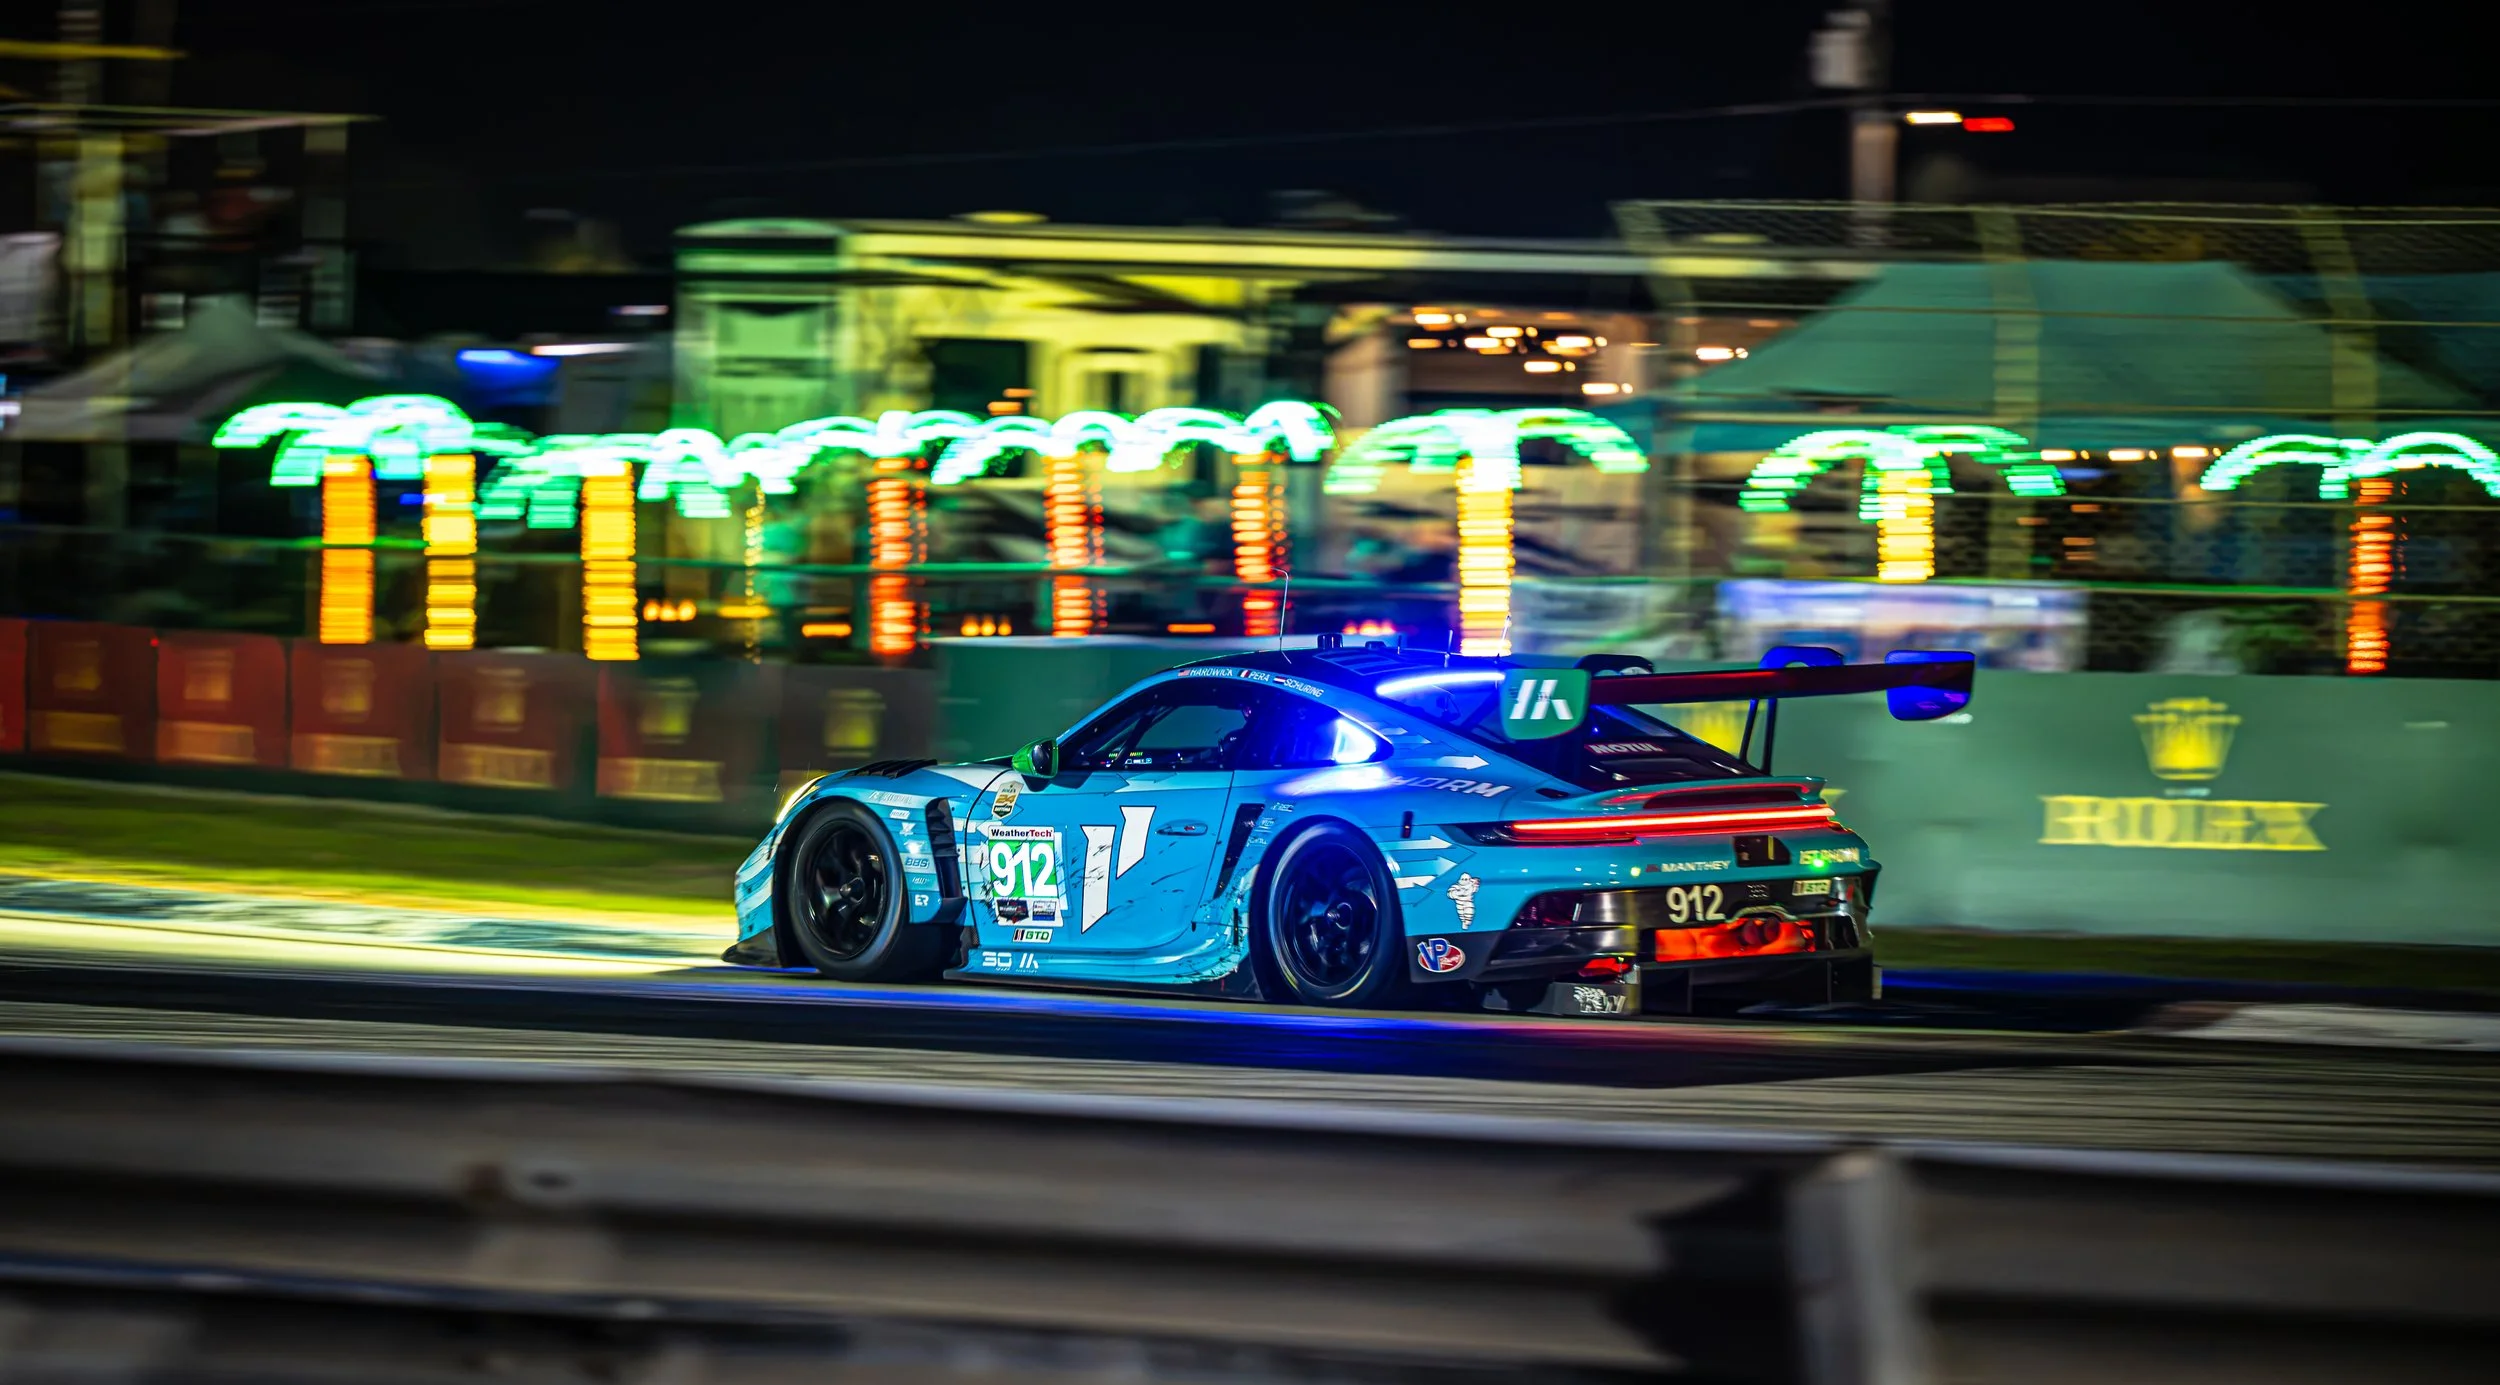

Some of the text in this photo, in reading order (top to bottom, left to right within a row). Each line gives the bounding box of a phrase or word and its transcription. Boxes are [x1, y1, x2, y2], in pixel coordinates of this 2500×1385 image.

[1190, 668, 1324, 698] HARDWICK PERA SCHURING
[1588, 743, 1664, 754] MOTUL
[995, 794, 1017, 804] 24
[991, 829, 1052, 837] WeatherTech
[905, 857, 929, 868] BBS
[1661, 861, 1731, 872] MANTHEY
[990, 842, 1058, 896] 912
[1666, 885, 1726, 923] 912
[1025, 930, 1050, 941] GTD
[1417, 938, 1449, 971] VP
